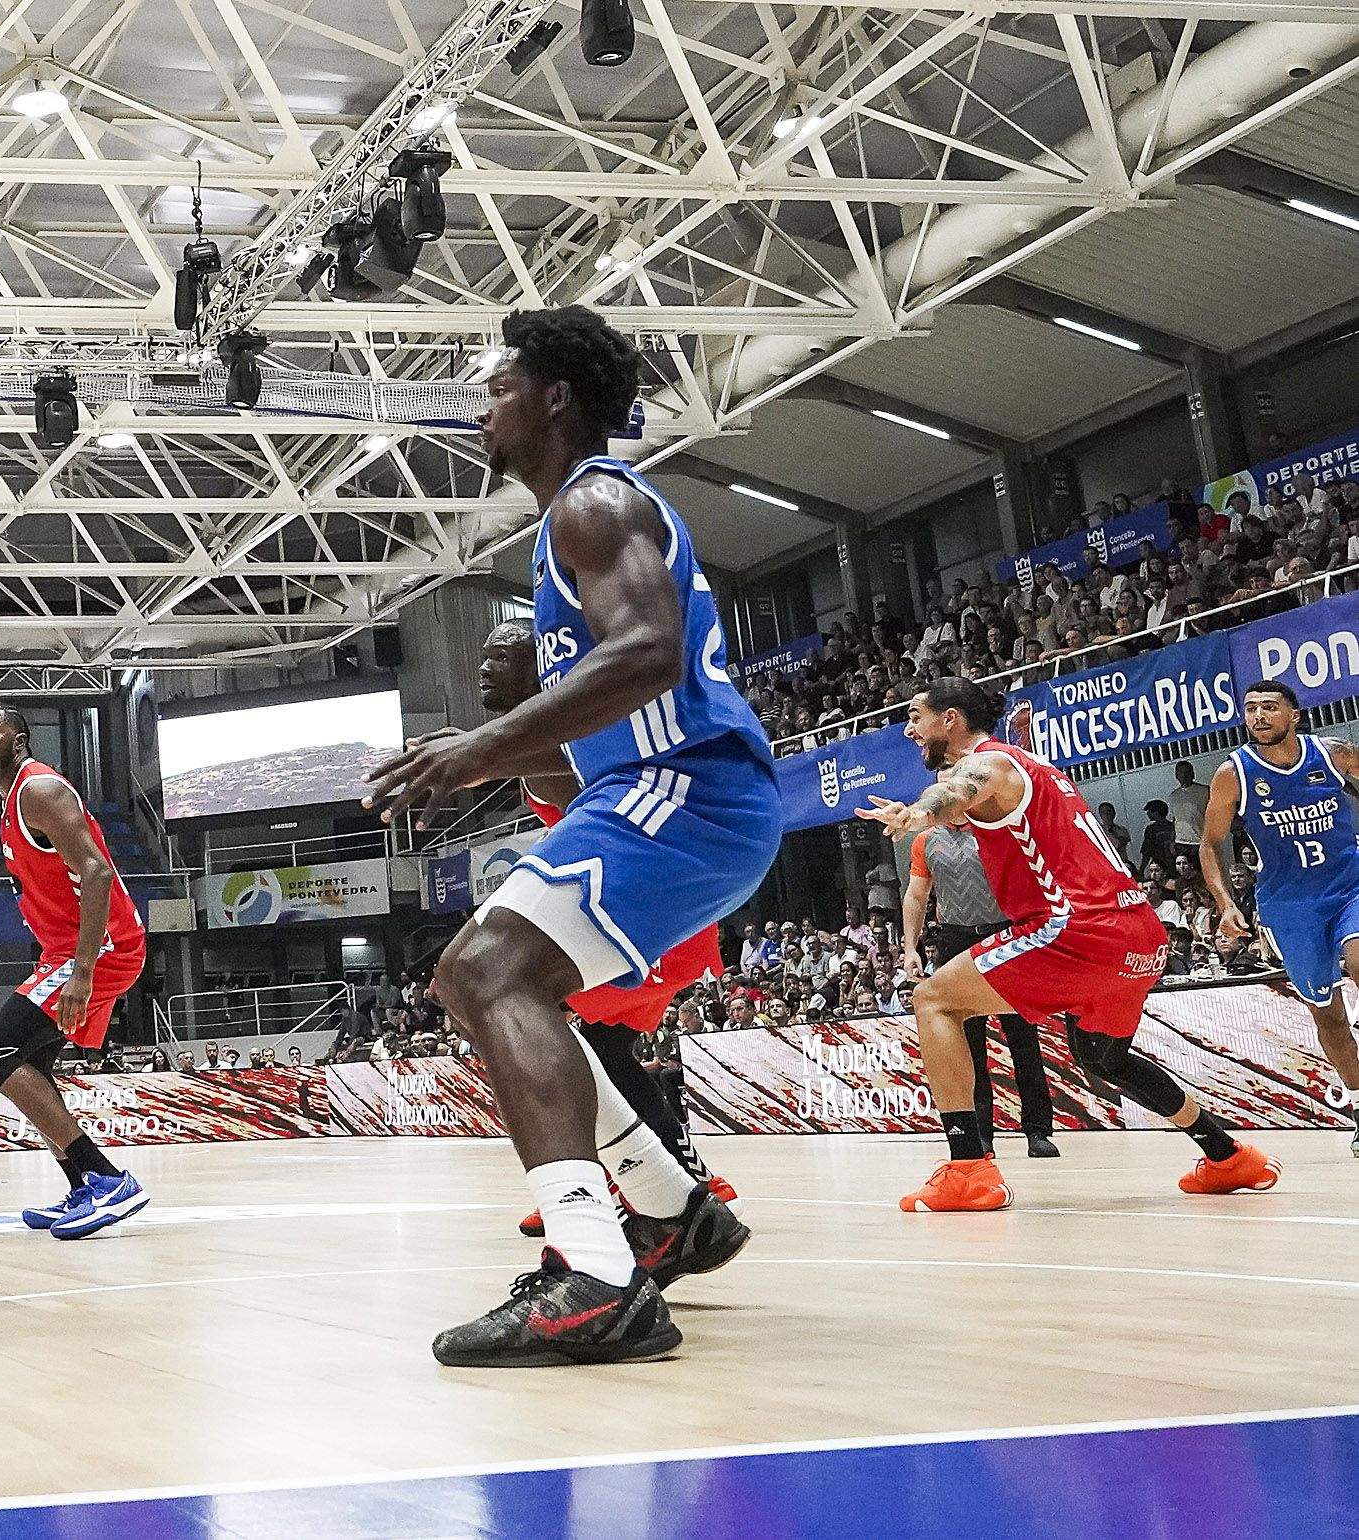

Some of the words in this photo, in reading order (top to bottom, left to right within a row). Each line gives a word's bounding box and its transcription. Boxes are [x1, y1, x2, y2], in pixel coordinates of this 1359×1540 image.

[1266, 442, 1359, 486] DEPORTE
[1109, 529, 1137, 545] Concello
[744, 651, 793, 676] DEPORTE
[1052, 671, 1127, 708] TORNEO
[1033, 671, 1235, 761] ENCESTARÍAS
[841, 764, 866, 780] Concello
[842, 781, 851, 792] de
[850, 772, 886, 790] Pontevedra
[1258, 797, 1339, 826] Emirates
[1279, 824, 1295, 838] FLY
[1298, 815, 1334, 836] BETTER
[1293, 840, 1327, 869] 13
[288, 877, 349, 890] DEPORTE
[289, 886, 378, 901] PONTEVEDRA
[801, 1033, 905, 1076] MADERAS
[386, 1066, 438, 1096] MADERAS
[64, 1088, 140, 1110] DERAS
